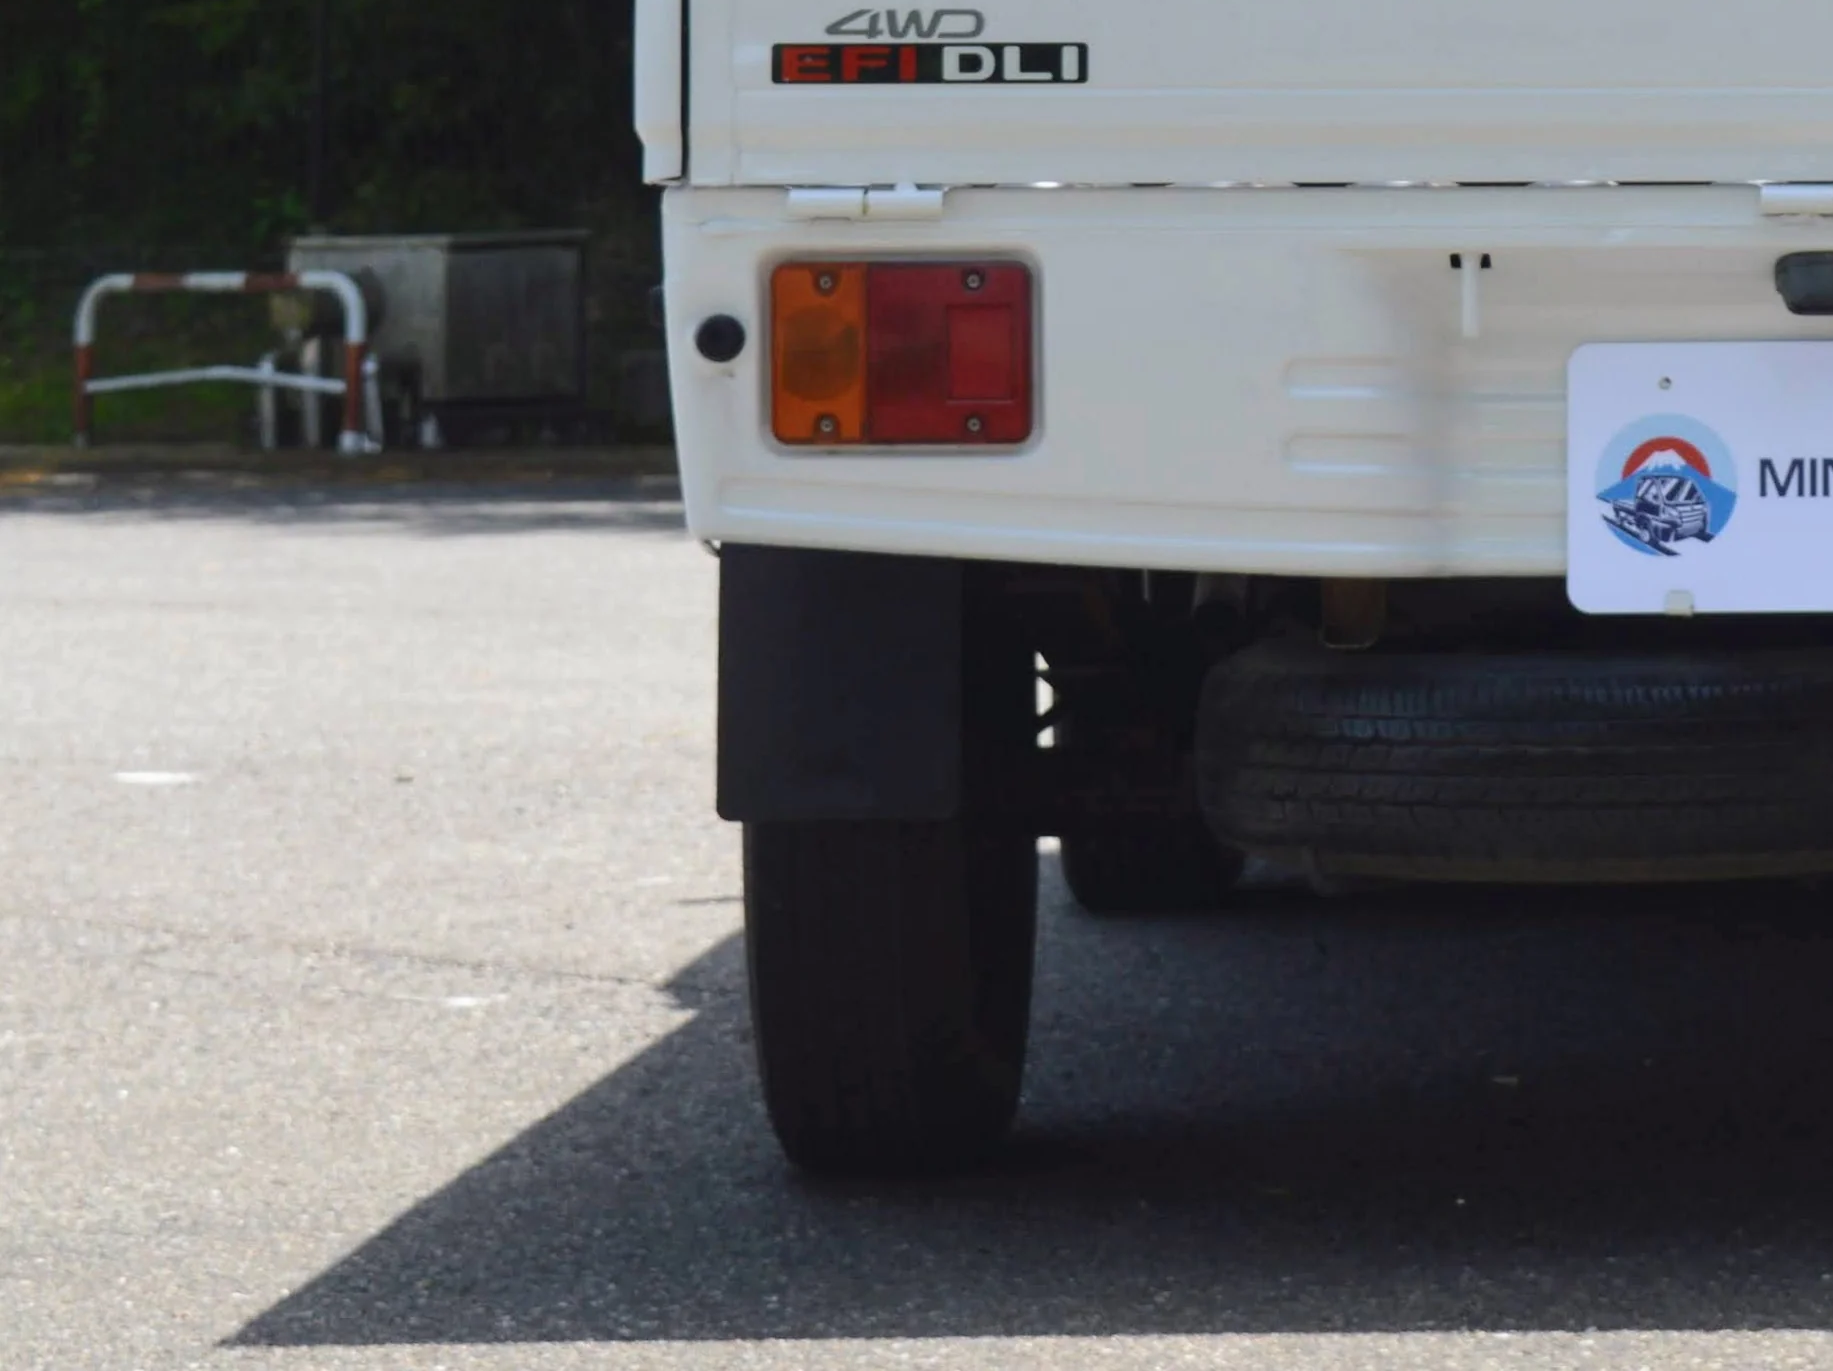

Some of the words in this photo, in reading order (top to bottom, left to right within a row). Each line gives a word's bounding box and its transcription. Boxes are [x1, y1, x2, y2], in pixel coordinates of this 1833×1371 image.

[824, 8, 985, 39] 4WD
[780, 46, 918, 82] EFI
[940, 44, 1080, 82] DLI
